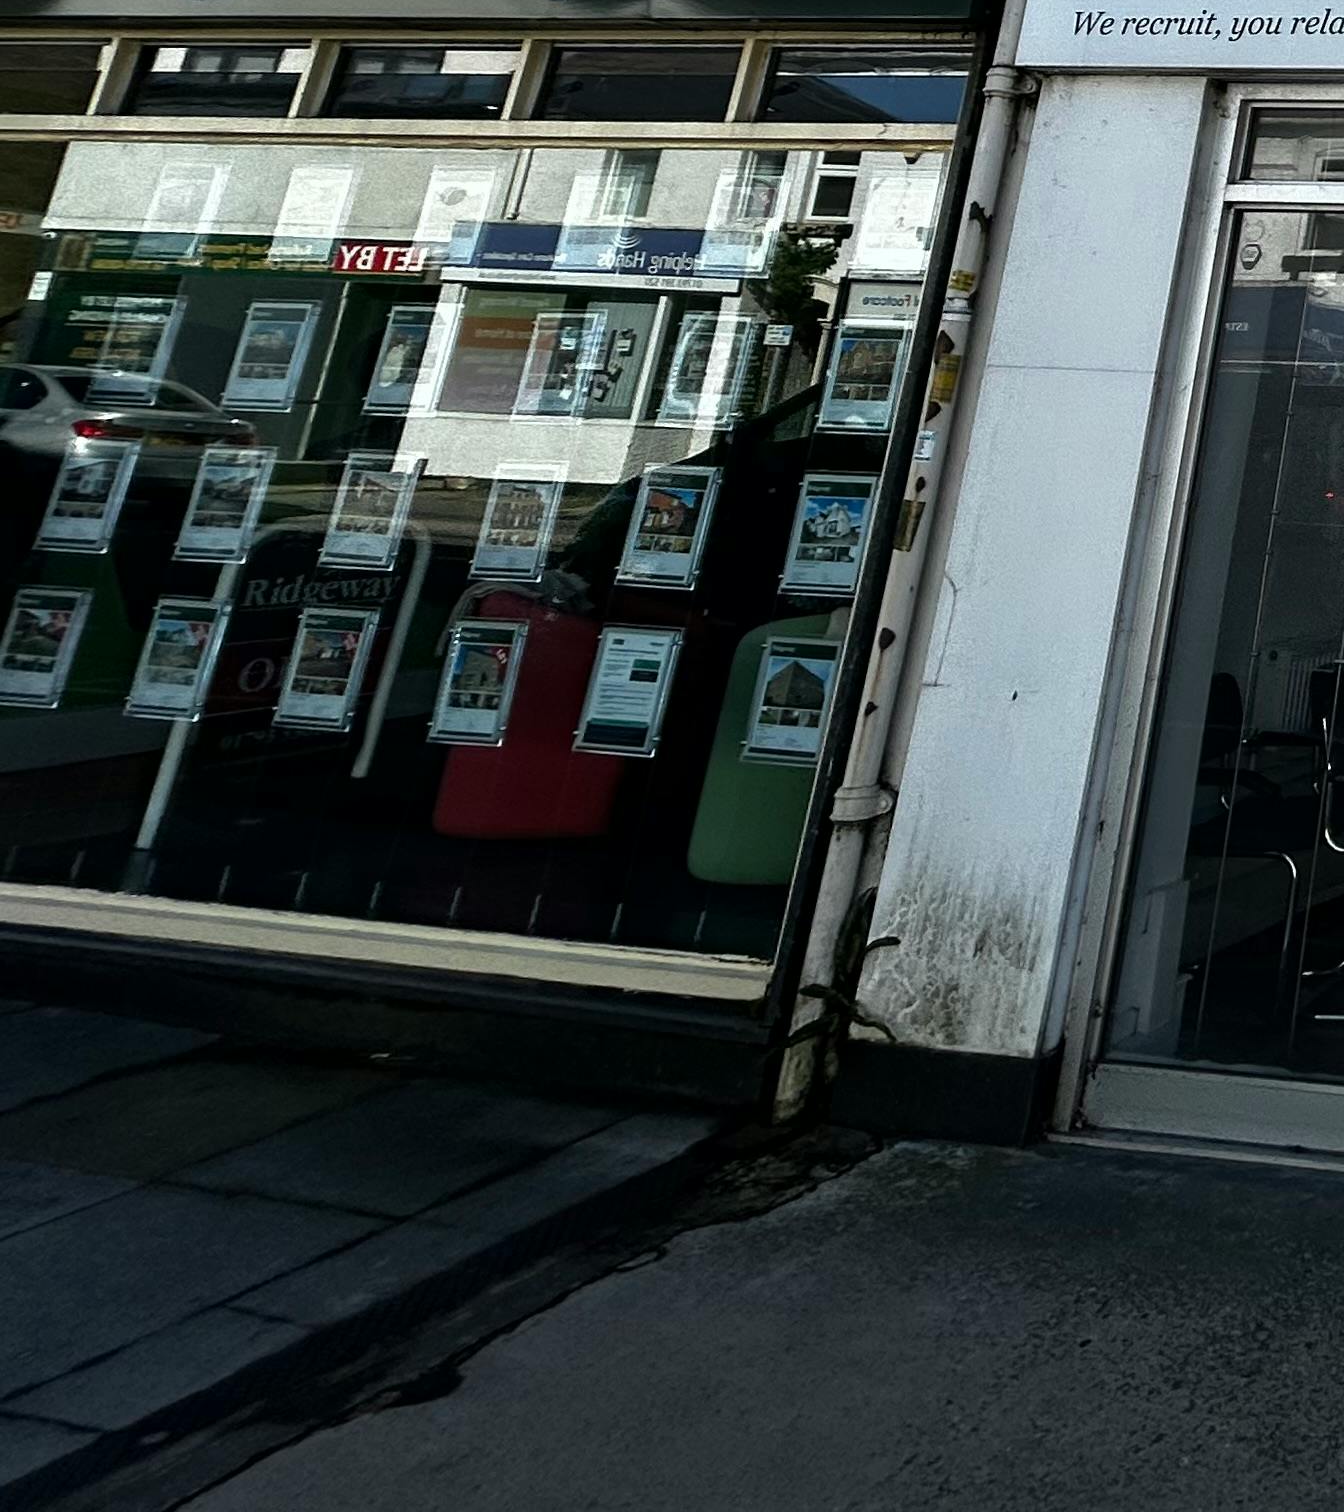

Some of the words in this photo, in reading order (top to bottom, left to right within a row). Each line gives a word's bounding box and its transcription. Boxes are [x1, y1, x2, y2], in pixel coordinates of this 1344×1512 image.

[1073, 11, 1114, 36] We
[1121, 10, 1221, 39] recruit,
[1229, 18, 1283, 41] you
[242, 572, 402, 609] Ridgeway
